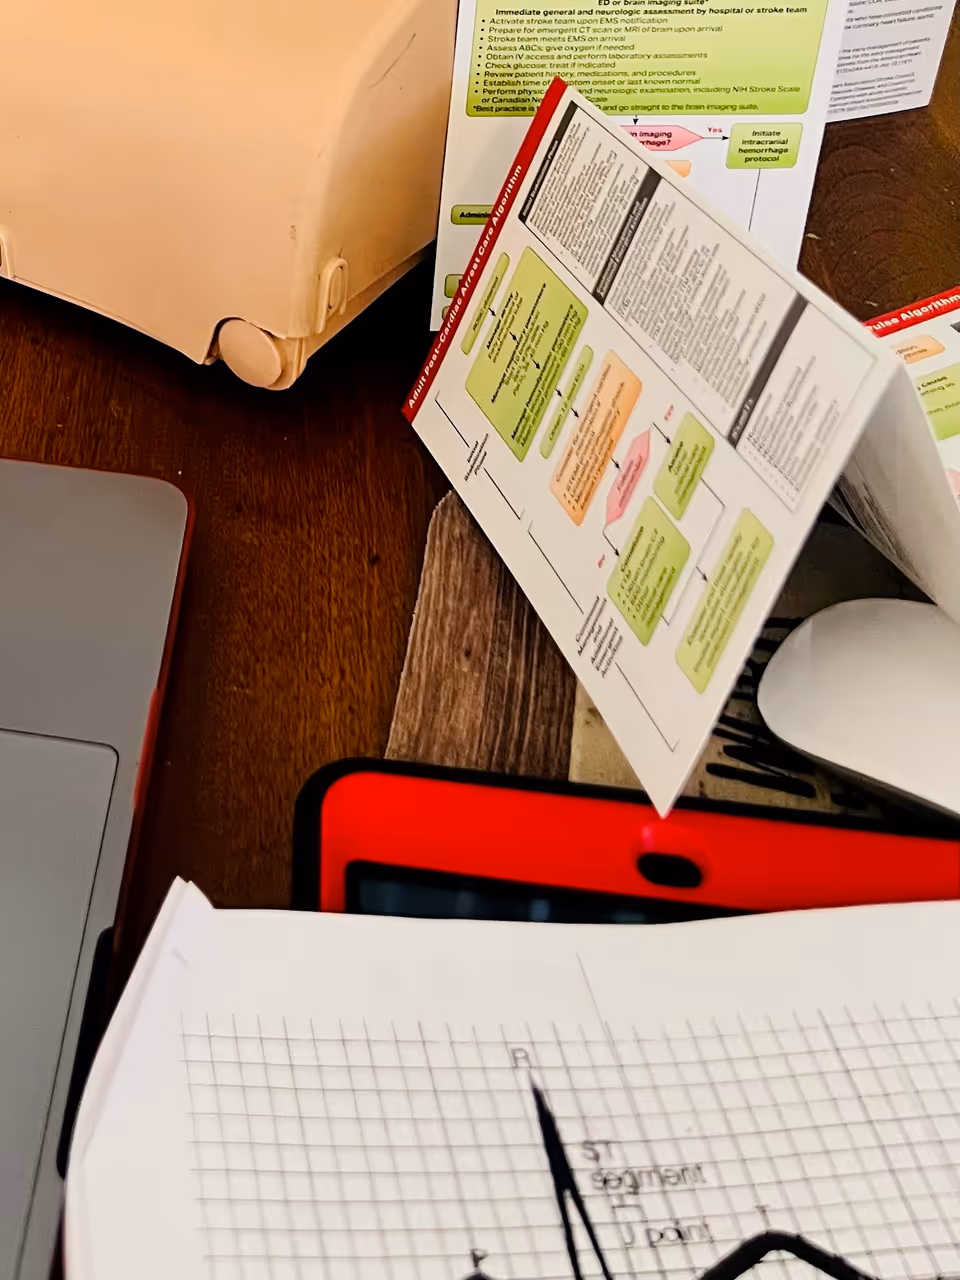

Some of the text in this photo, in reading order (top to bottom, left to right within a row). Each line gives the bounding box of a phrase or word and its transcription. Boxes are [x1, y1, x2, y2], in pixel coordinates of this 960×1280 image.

[408, 165, 522, 408] Adult Post-Cardiac Arrest Care Algorithm
[900, 294, 960, 321] Algorithm
[512, 1047, 530, 1069] R
[581, 1140, 616, 1161] ST
[591, 1164, 707, 1195] segment
[624, 1218, 715, 1248] J point
